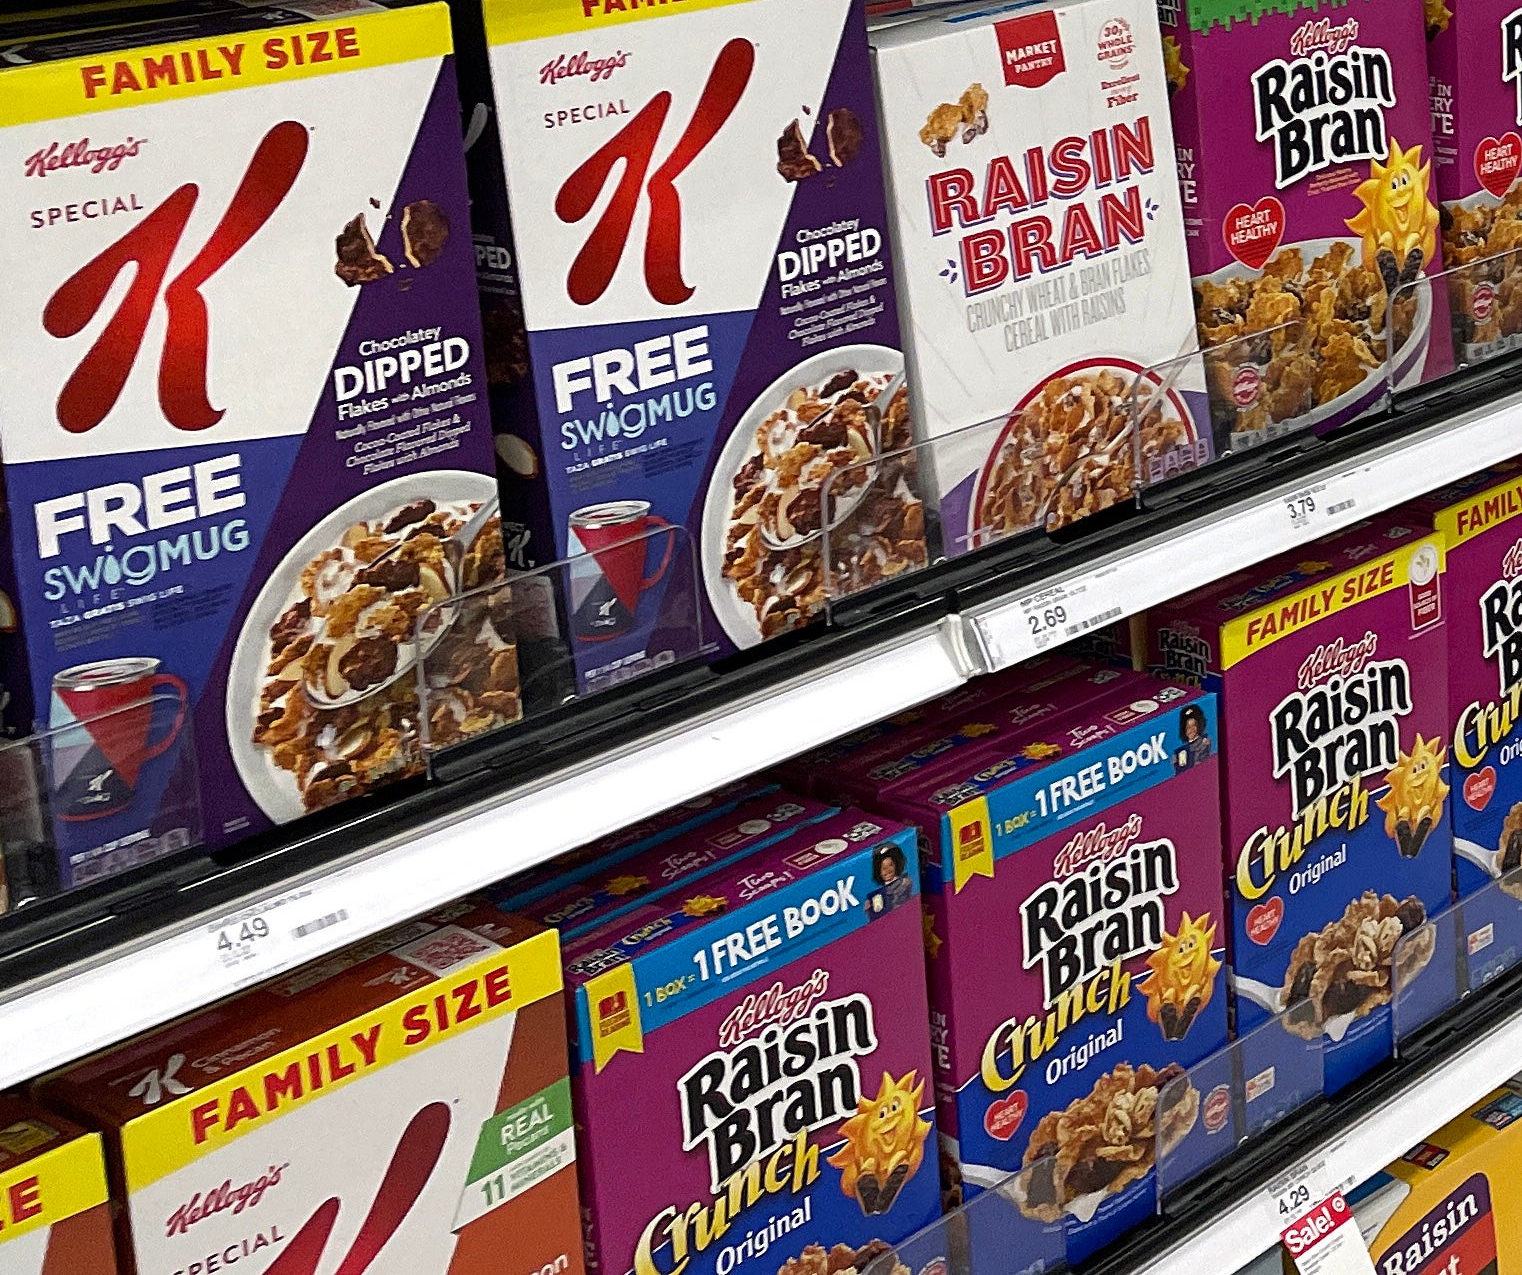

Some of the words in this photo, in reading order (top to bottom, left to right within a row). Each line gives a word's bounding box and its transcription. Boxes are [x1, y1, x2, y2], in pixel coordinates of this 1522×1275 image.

[80, 42, 246, 99] FAMILY
[264, 27, 361, 70] SIZE
[1254, 47, 1394, 136] Raisin
[544, 98, 632, 129] SPECIAL
[1107, 92, 1139, 109] Fiber
[925, 115, 1156, 237] RAISIN
[1275, 105, 1387, 183] Bran
[30, 193, 145, 229] SPECIAL
[959, 185, 1147, 298] BRAN
[1230, 222, 1278, 245] HEALTHY
[1235, 209, 1271, 230] HEART
[777, 228, 883, 282] DIPPED
[334, 336, 471, 402] DIPPED
[551, 324, 714, 414] FREE
[34, 453, 247, 559] FREE
[1287, 496, 1317, 520] 3.79
[1028, 606, 1068, 635] 2.69
[1246, 585, 1337, 647] FAMILY
[1341, 561, 1395, 604] SIZE
[1273, 663, 1410, 772] Raisin
[1108, 730, 1170, 781] BOOK
[215, 917, 271, 952] 4.49
[712, 914, 782, 974] FREE
[785, 875, 860, 941] BOOK
[1025, 843, 1177, 965] Raisin
[189, 1024, 381, 1145] FAMILY
[402, 964, 513, 1046] SIZE
[981, 957, 1132, 1093] Crunch
[1045, 1019, 1125, 1086] Original
[684, 999, 873, 1147] Raisin
[1283, 1209, 1336, 1255] Sale!
